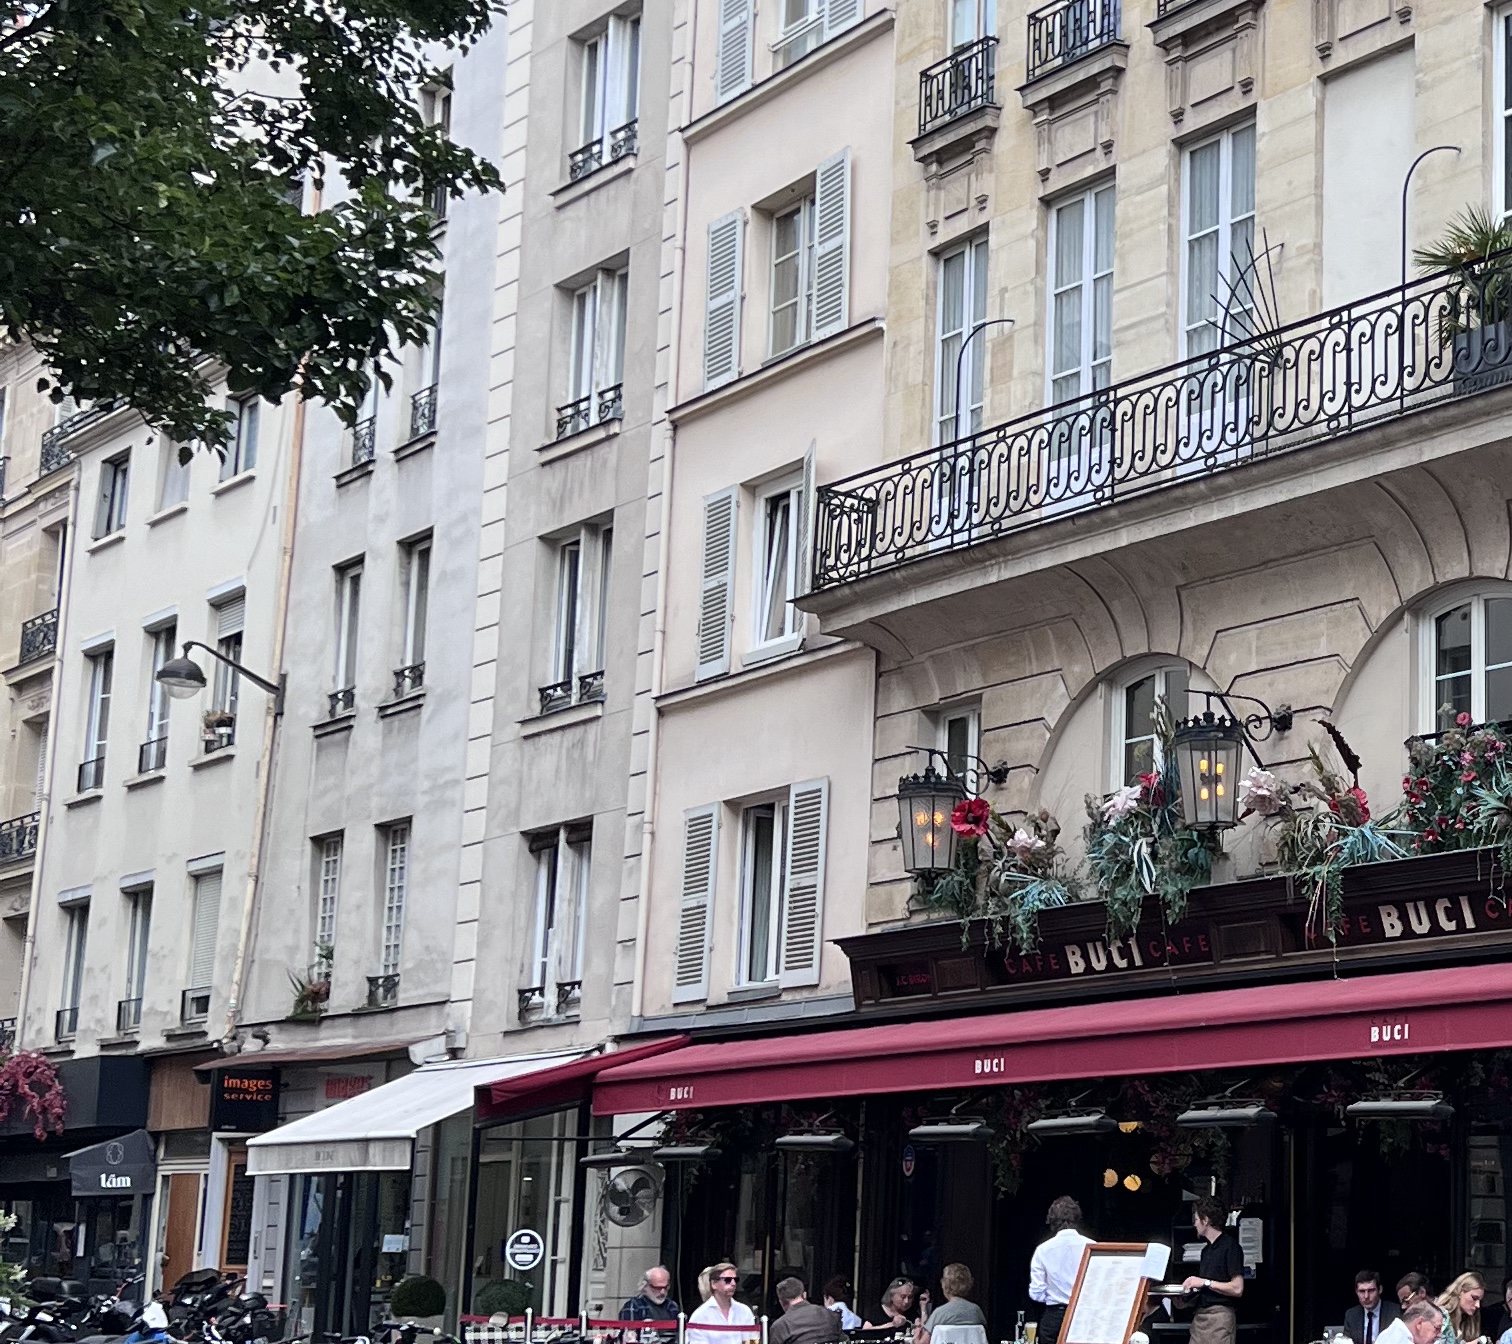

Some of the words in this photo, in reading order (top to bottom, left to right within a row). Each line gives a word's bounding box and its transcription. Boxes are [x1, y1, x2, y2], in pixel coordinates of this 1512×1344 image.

[1378, 895, 1476, 938] BUCI
[1064, 937, 1143, 975] BUCI
[1370, 1023, 1409, 1042] BUCI
[974, 1057, 1005, 1074] BUCI
[224, 1075, 273, 1092] images
[223, 1092, 272, 1101] service
[670, 1086, 694, 1101] BUCI
